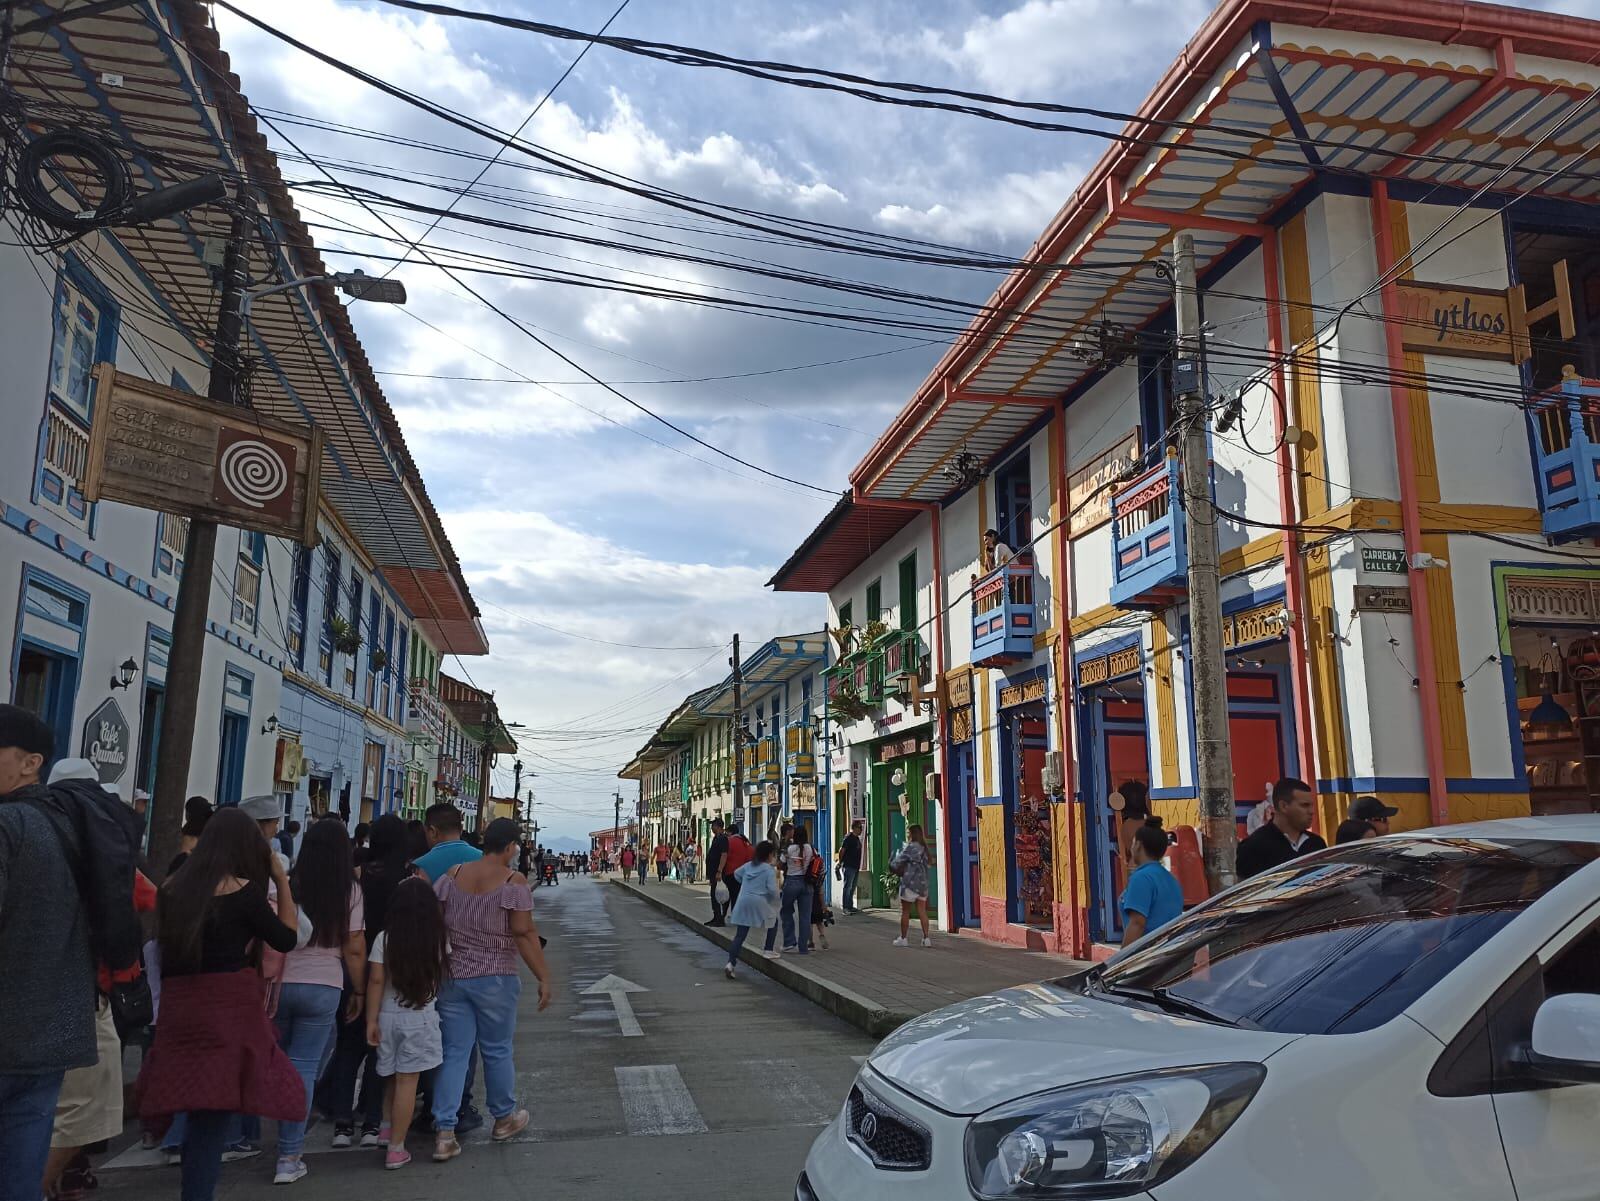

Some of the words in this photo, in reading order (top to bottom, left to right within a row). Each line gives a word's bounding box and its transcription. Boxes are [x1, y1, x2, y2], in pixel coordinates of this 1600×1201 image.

[1362, 550, 1397, 561] CARRERA
[1399, 551, 1406, 562] 7
[1365, 562, 1393, 571] CALLE
[1395, 563, 1401, 572] 7
[100, 720, 122, 748] Café
